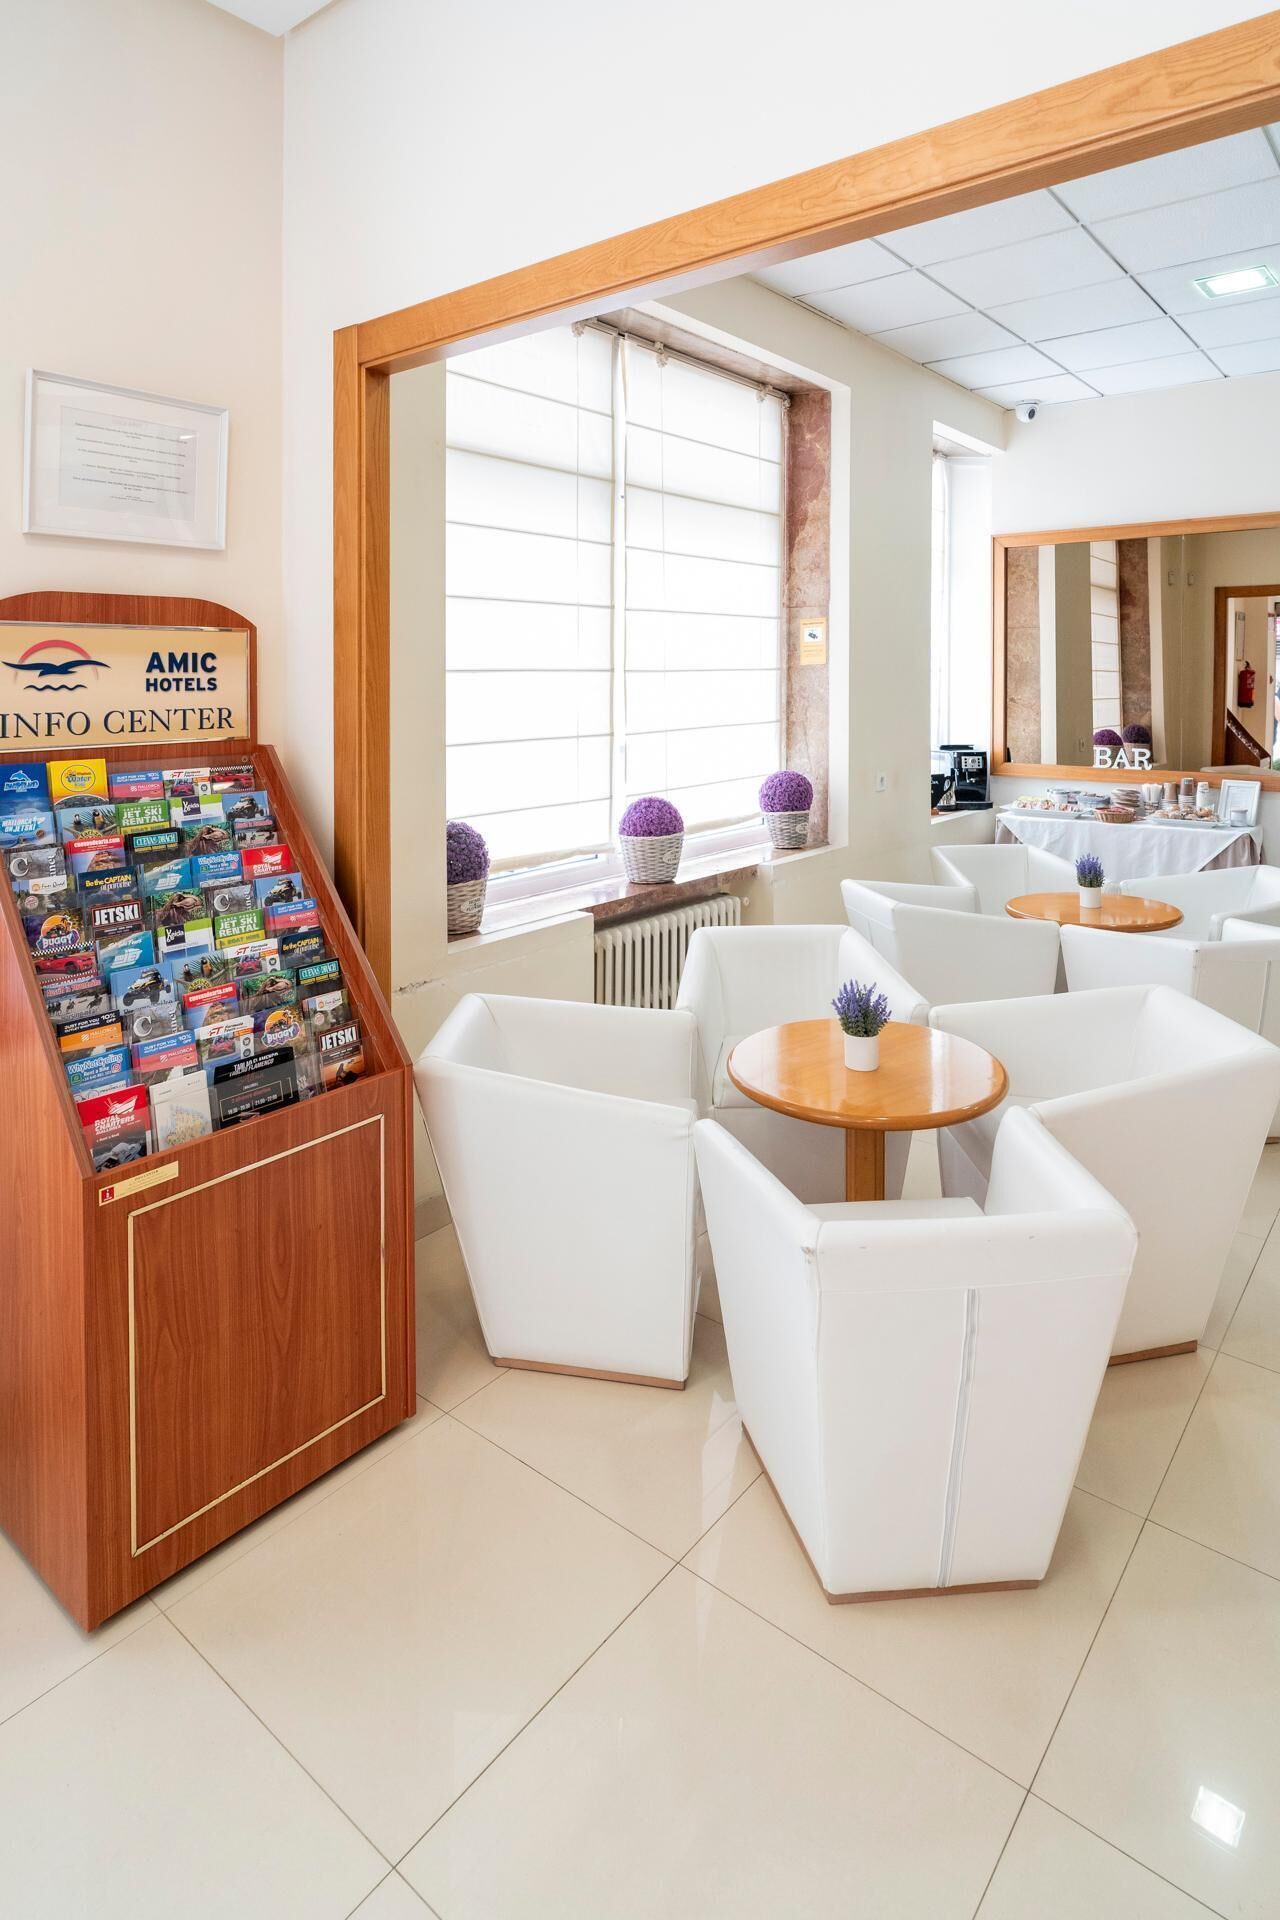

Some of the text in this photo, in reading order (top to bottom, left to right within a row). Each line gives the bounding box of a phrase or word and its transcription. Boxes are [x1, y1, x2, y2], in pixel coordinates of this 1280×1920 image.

[146, 652, 217, 673] AMIC
[146, 678, 217, 692] HOTELS
[0, 707, 235, 738] INFO CENTER
[1093, 747, 1153, 770] BAR
[124, 806, 162, 819] JET SKI
[123, 815, 165, 827] RENTAL
[104, 874, 132, 884] CAPTAIN
[95, 903, 139, 926] JETSKI
[220, 915, 257, 930] JET SKI
[219, 923, 259, 938] RENTAL
[42, 934, 73, 949] BUGGY
[297, 936, 320, 947] CAPTAIN
[266, 1026, 294, 1044] BUGGY
[321, 1026, 357, 1051] JETSKI
[168, 1047, 193, 1057] MALLORCA
[94, 1114, 120, 1126] ROYAL
[94, 1114, 135, 1133] CHARTERS
